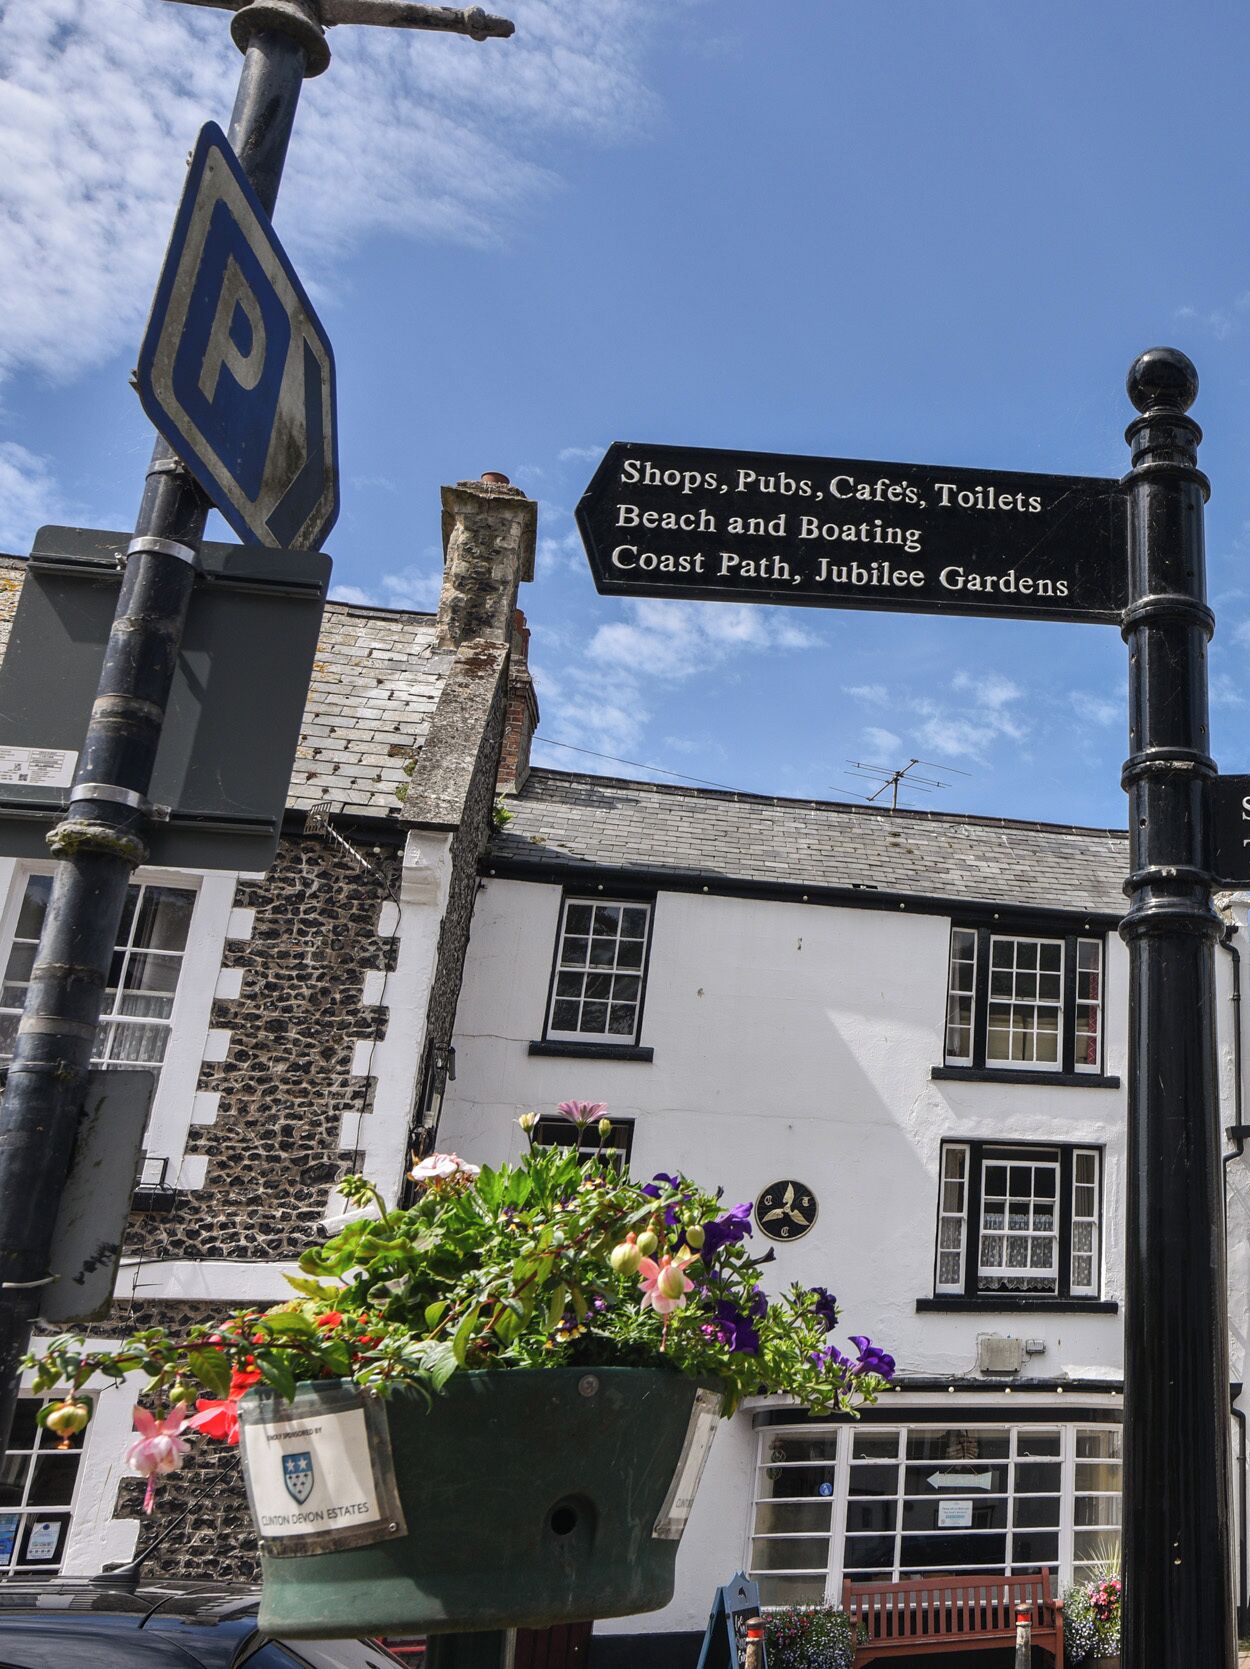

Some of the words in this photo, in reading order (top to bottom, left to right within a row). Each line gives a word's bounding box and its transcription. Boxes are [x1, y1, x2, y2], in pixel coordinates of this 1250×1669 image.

[198, 253, 267, 405] P
[620, 459, 728, 494] Shops,
[734, 469, 824, 501] Pubs,
[934, 483, 1042, 513] Toilets
[615, 504, 717, 533] Beach
[727, 513, 787, 537] and
[798, 515, 922, 553] Boating
[611, 544, 705, 573] Coast
[716, 552, 801, 585] Path,
[815, 558, 925, 587] Jubilee
[938, 566, 1069, 597] Gardens
[291, 1511, 324, 1524] DEVON
[327, 1502, 370, 1519] ESTATES
